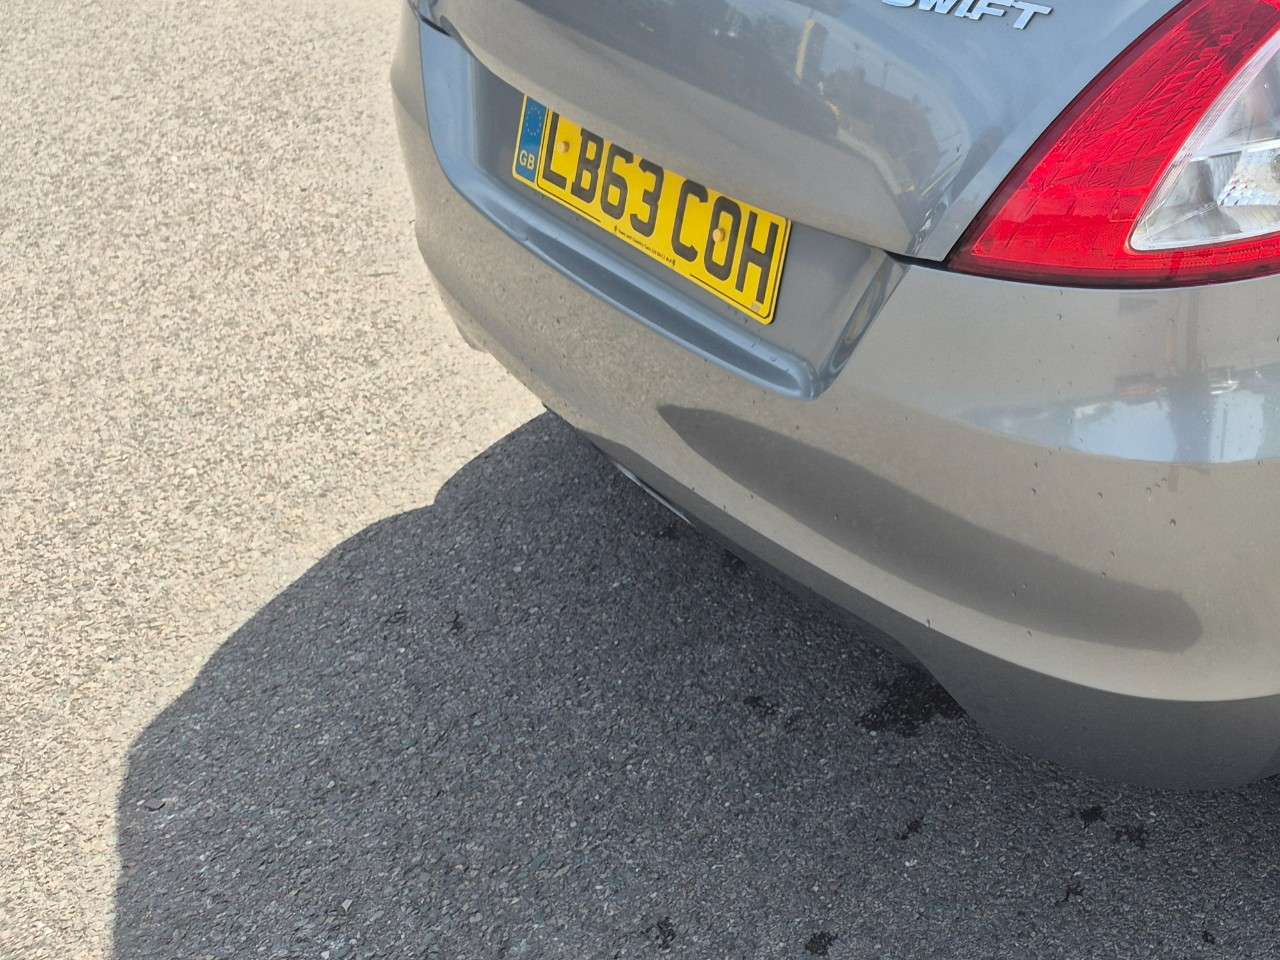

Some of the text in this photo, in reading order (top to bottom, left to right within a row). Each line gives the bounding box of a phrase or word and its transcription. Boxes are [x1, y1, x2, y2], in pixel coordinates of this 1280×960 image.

[519, 150, 535, 170] GB
[541, 111, 780, 305] LB63 COH
